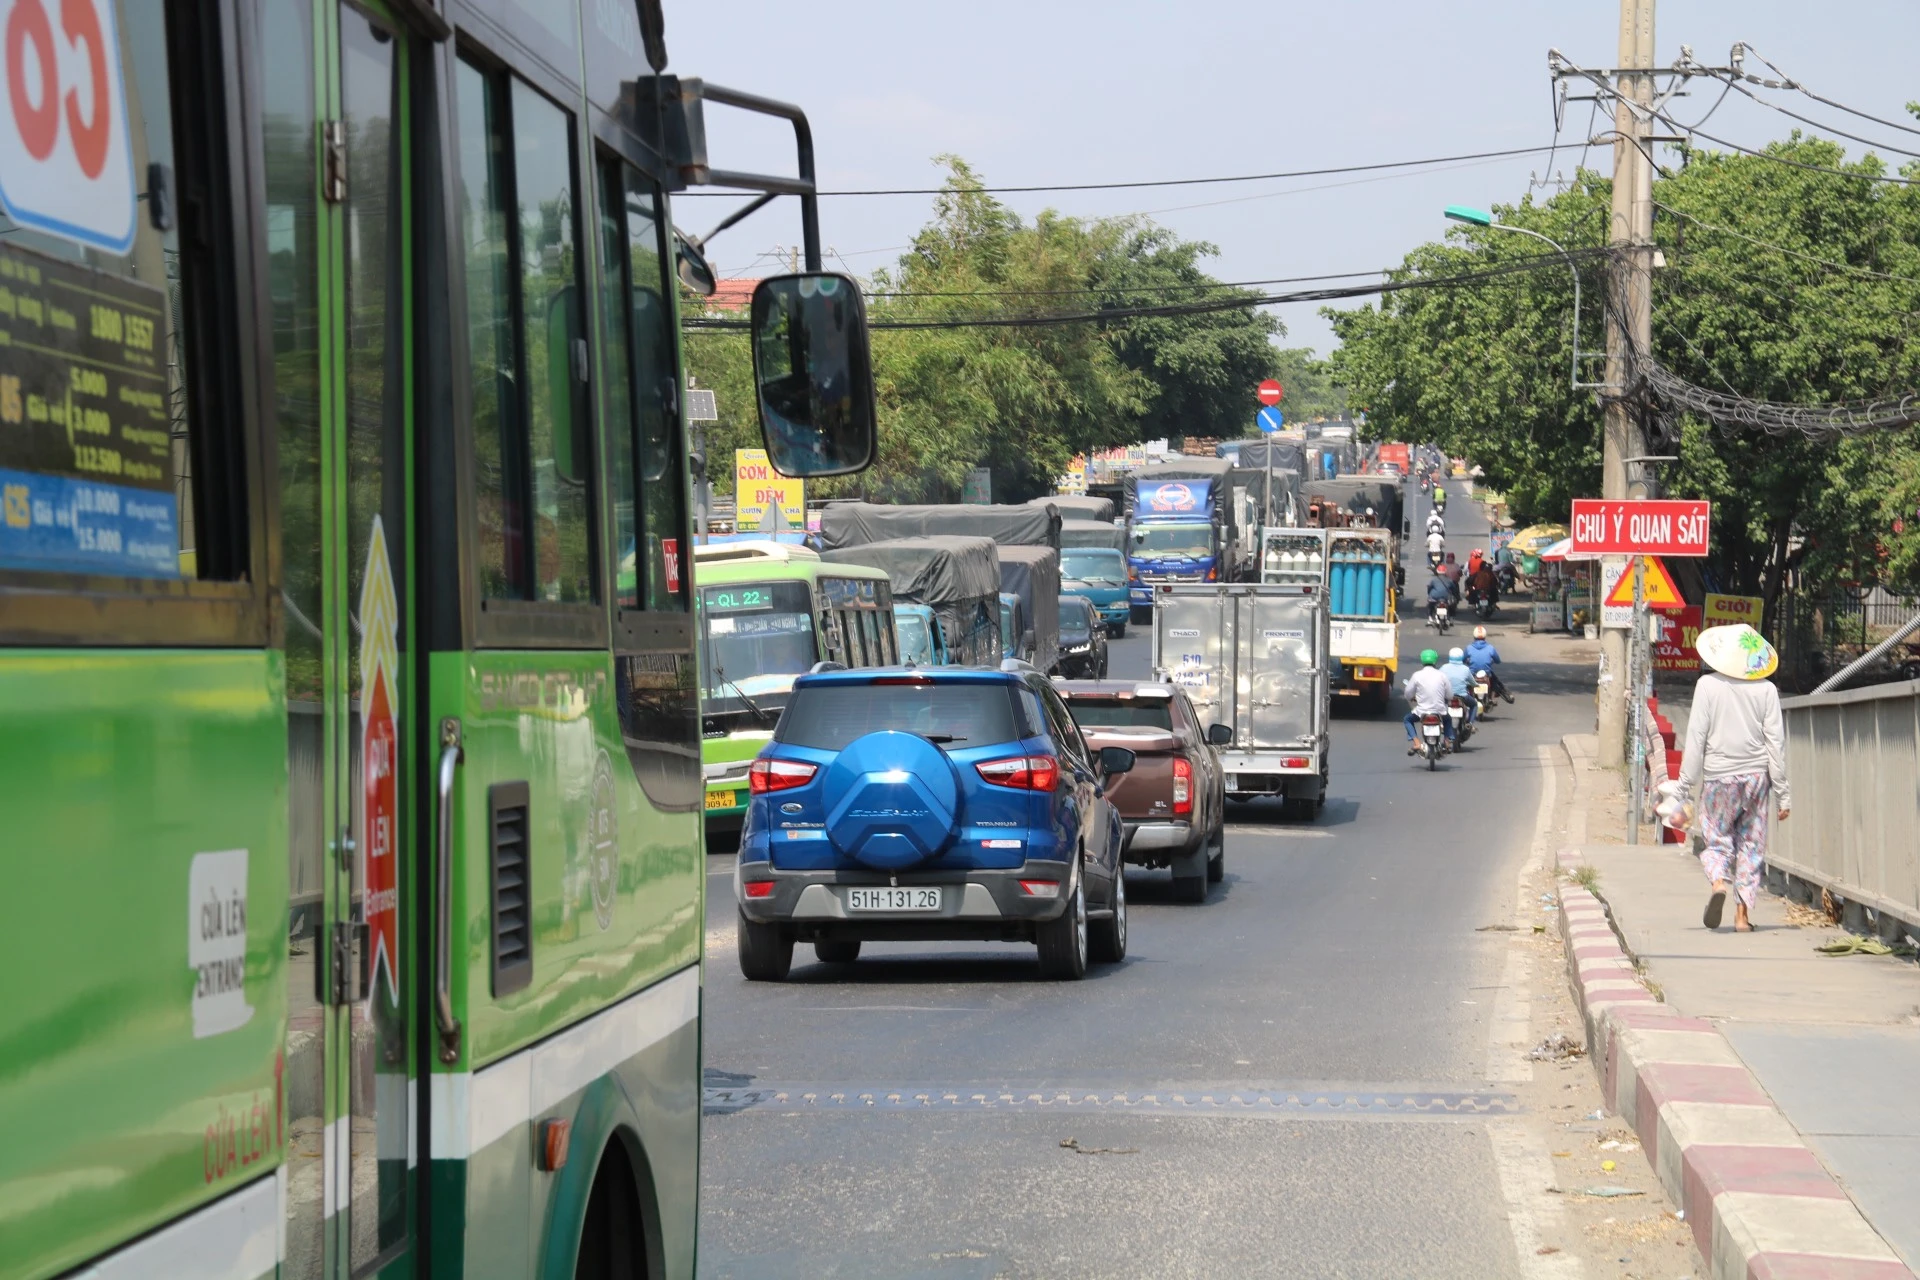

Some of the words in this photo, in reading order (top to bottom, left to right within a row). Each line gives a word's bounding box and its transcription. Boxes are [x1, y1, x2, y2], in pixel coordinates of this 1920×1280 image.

[738, 463, 768, 480] CƠM
[756, 485, 785, 504] ĐÊM
[1575, 506, 1606, 543] CHÚ
[1613, 505, 1625, 543] Ý
[1630, 514, 1671, 544] QUAN
[1678, 507, 1707, 545] SÁT
[718, 593, 740, 608] QL
[743, 591, 761, 605] 22
[1714, 599, 1753, 615] GIỚI
[371, 805, 391, 858] LÊN
[366, 887, 397, 917] Entrance
[851, 890, 938, 908] 51H-131.26
